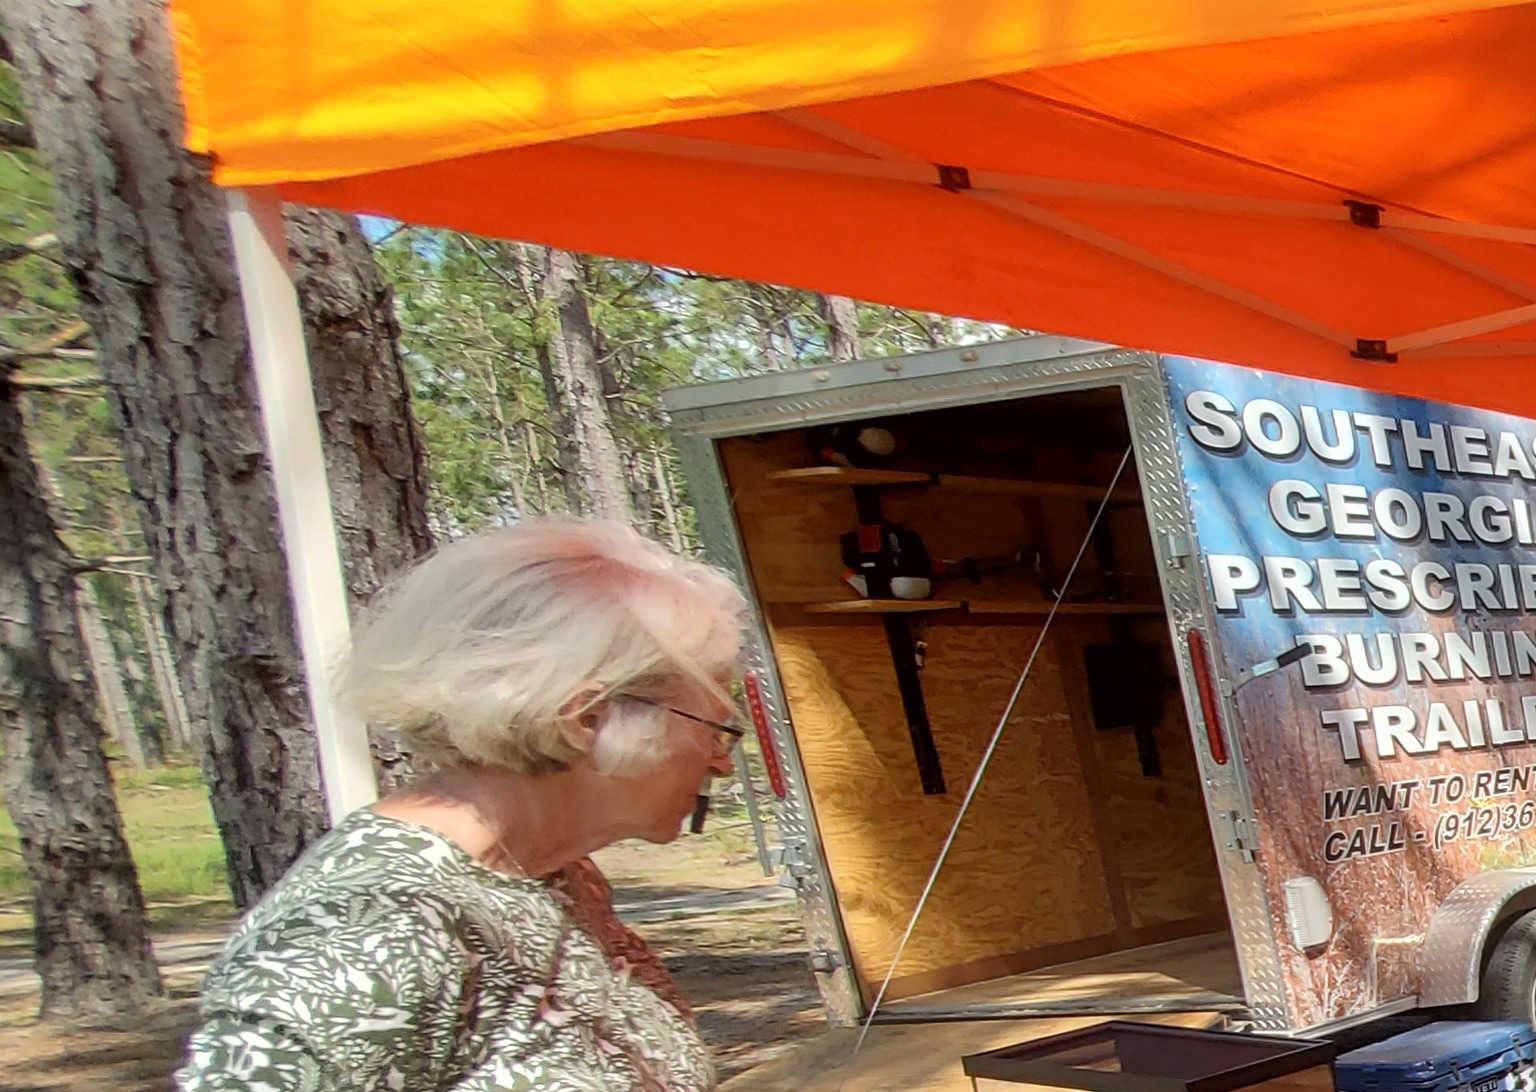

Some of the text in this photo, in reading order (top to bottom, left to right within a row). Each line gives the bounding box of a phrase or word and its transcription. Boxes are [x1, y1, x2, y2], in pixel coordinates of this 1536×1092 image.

[1323, 779, 1421, 822] WANT
[1428, 775, 1466, 808] TO
[1323, 821, 1406, 864] CALL
